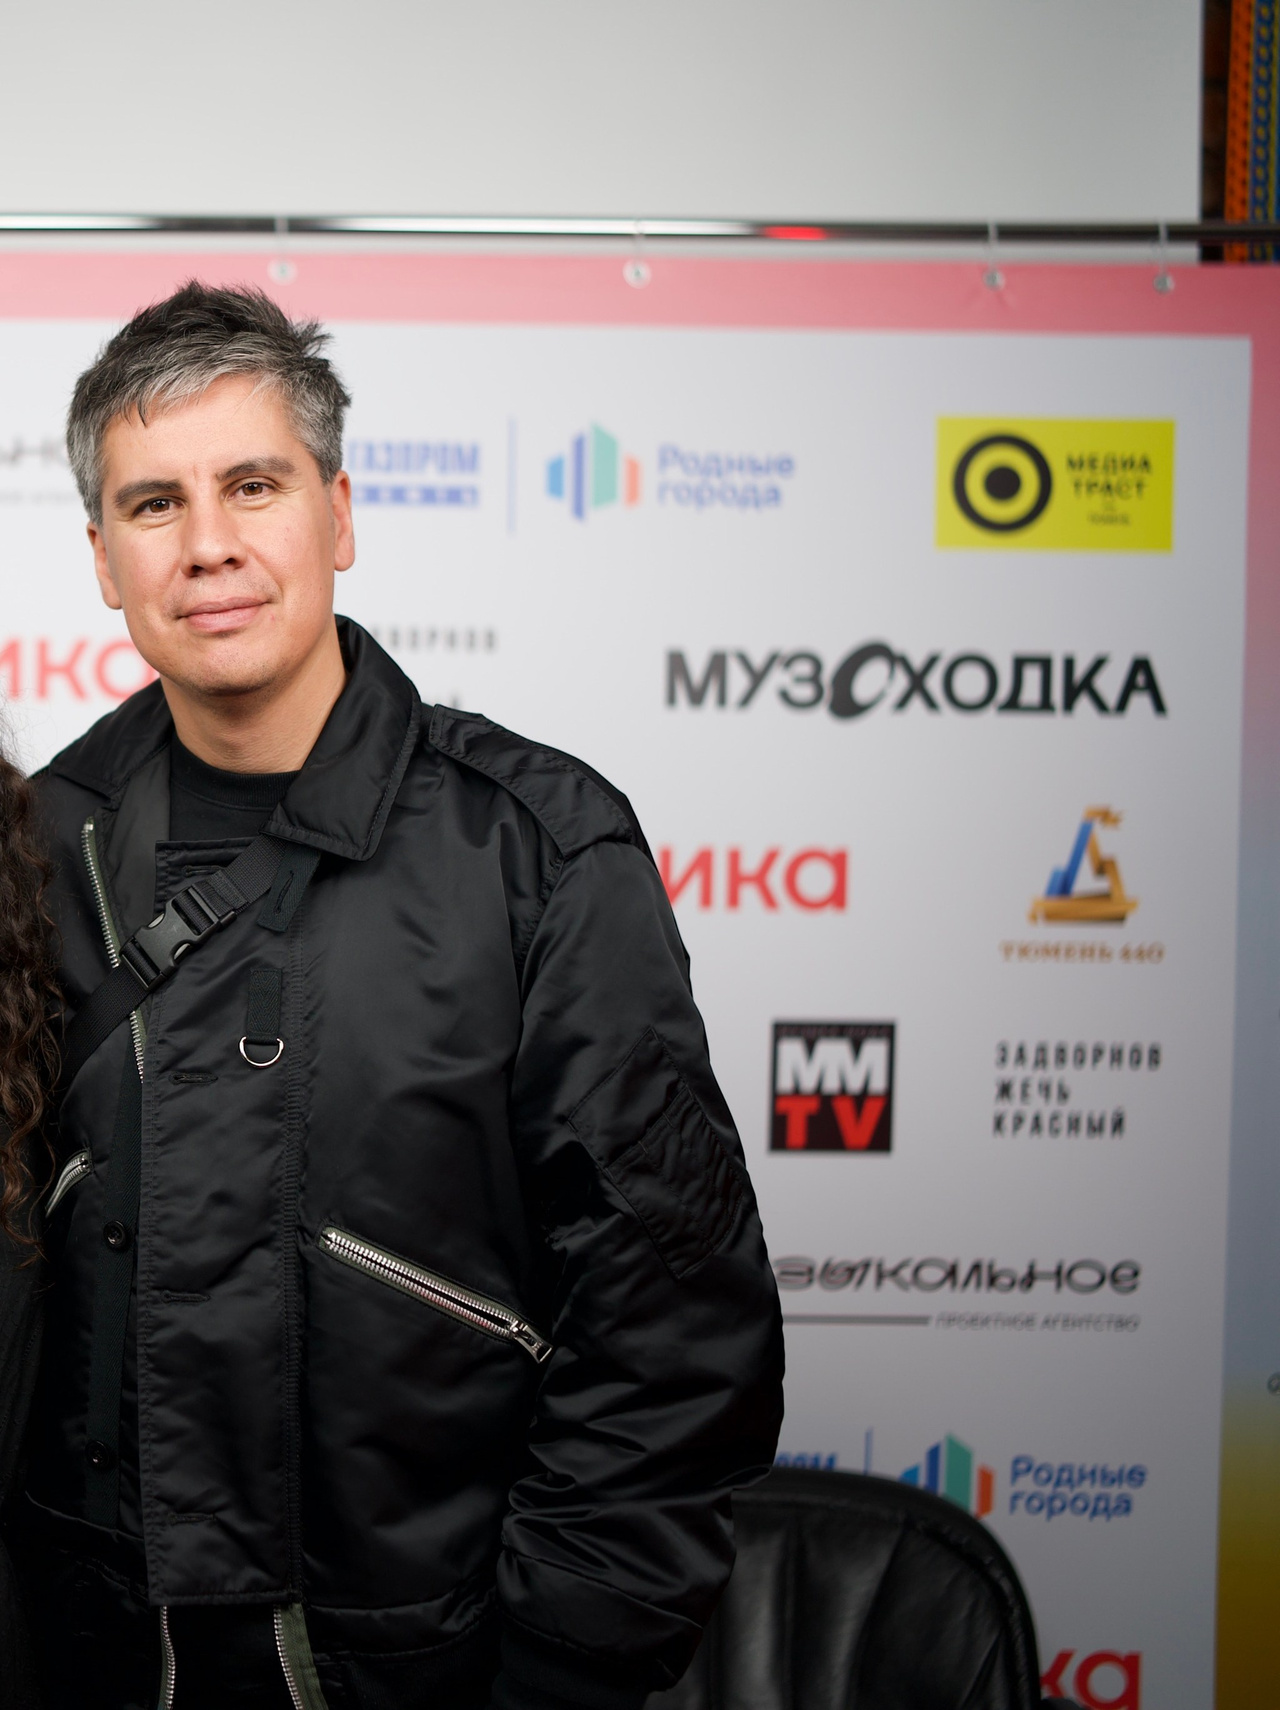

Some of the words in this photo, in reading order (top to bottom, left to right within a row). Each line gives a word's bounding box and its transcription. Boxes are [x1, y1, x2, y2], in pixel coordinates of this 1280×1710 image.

[657, 445, 795, 479] Родные
[657, 479, 783, 509] города
[995, 1041, 1162, 1071] ЗАДВОРНОВ
[995, 1077, 1071, 1106] ЖЕЧЬ
[775, 1094, 887, 1151] TV
[993, 1106, 1126, 1139] КРАСНЫЙ
[1008, 1454, 1149, 1492] Родные
[1008, 1490, 1134, 1522] города
